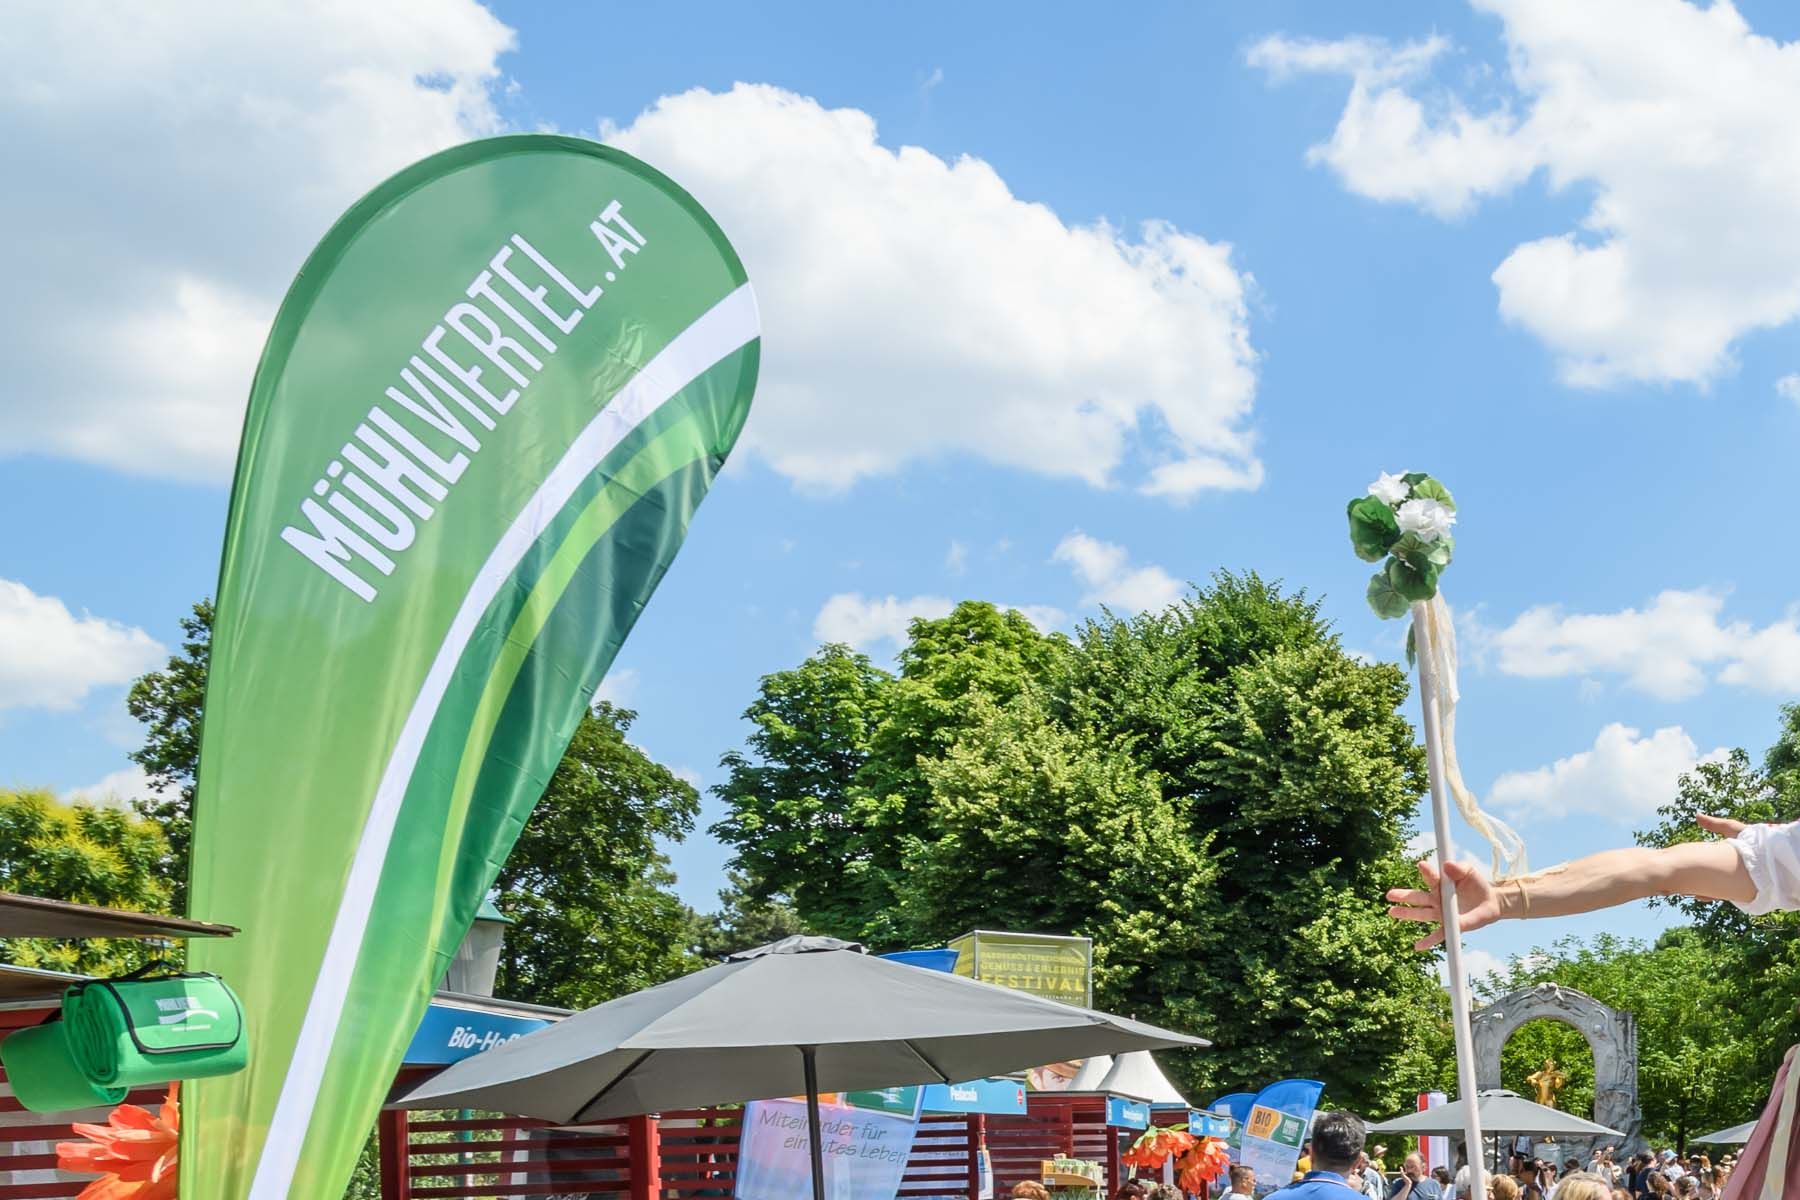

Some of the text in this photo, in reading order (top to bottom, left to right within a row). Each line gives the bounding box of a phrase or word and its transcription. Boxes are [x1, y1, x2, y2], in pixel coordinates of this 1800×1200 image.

[980, 973, 1085, 993] FESTIVAL
[1254, 1110, 1272, 1127] BIO
[861, 1122, 887, 1140] für
[783, 1133, 807, 1149] ein
[859, 1147, 907, 1167] Leben
